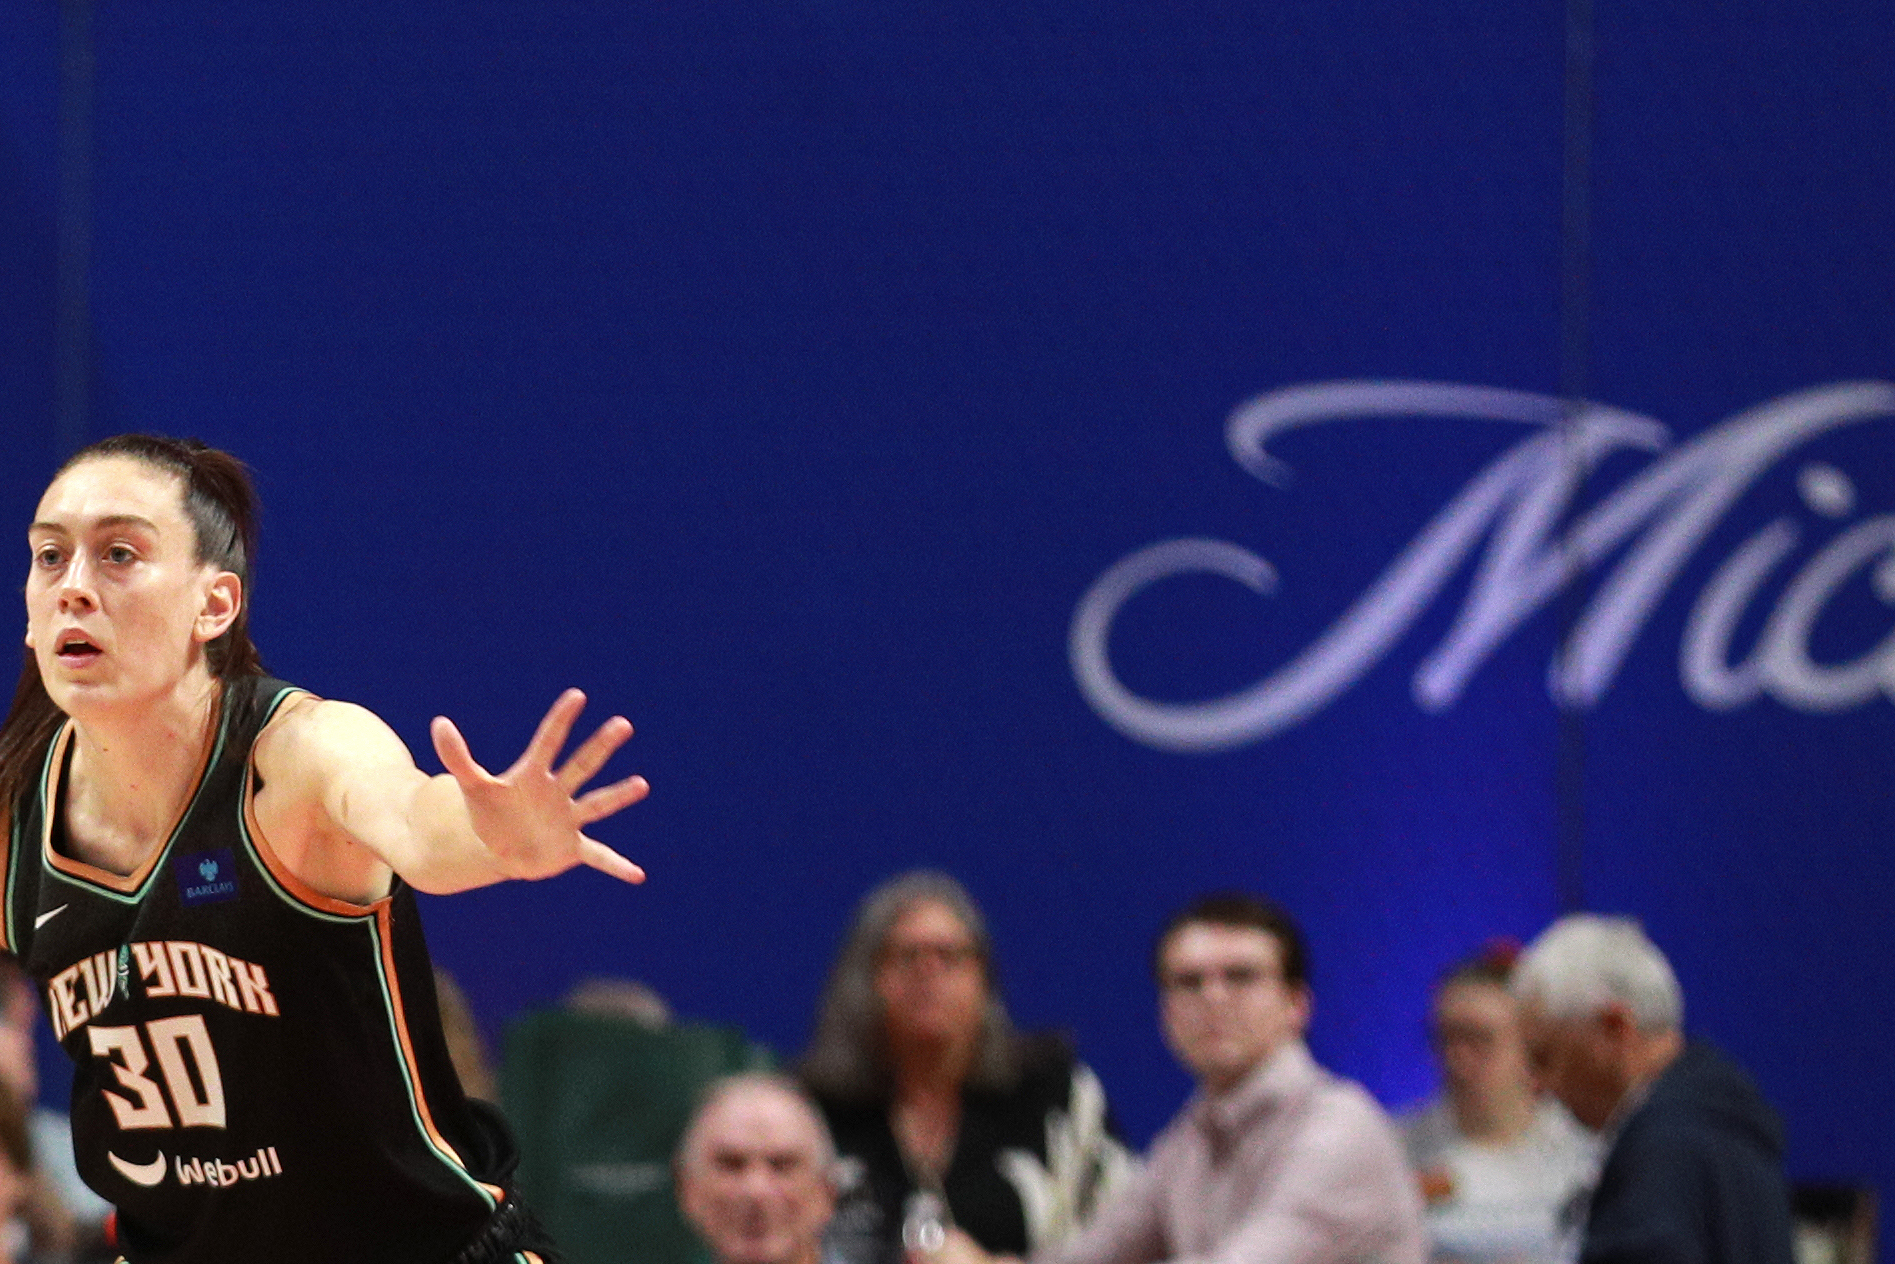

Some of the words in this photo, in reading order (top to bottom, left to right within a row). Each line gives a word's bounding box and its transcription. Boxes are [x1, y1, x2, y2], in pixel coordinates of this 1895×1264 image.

[130, 940, 280, 1017] YORK
[87, 1013, 227, 1130] 30
[175, 1146, 283, 1188] Webull
